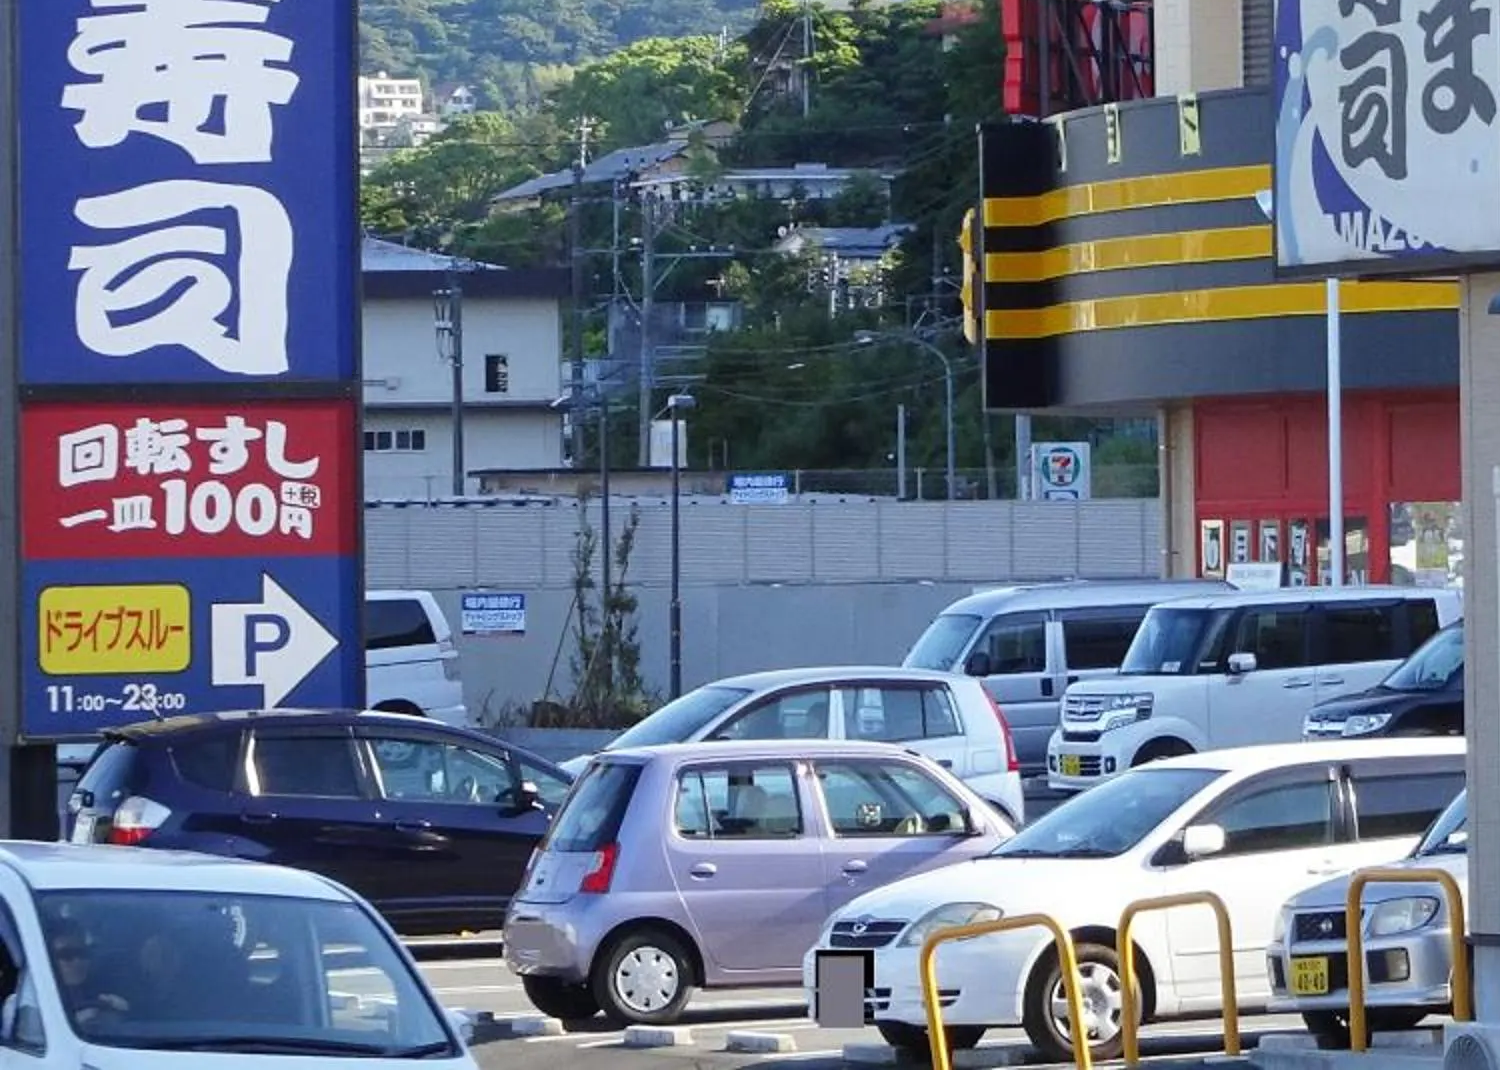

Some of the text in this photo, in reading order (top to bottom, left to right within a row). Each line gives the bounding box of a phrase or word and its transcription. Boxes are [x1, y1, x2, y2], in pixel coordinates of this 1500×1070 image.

[59, 416, 320, 487] 回転すし
[46, 606, 184, 654] ドライブスルー
[245, 614, 291, 677] P
